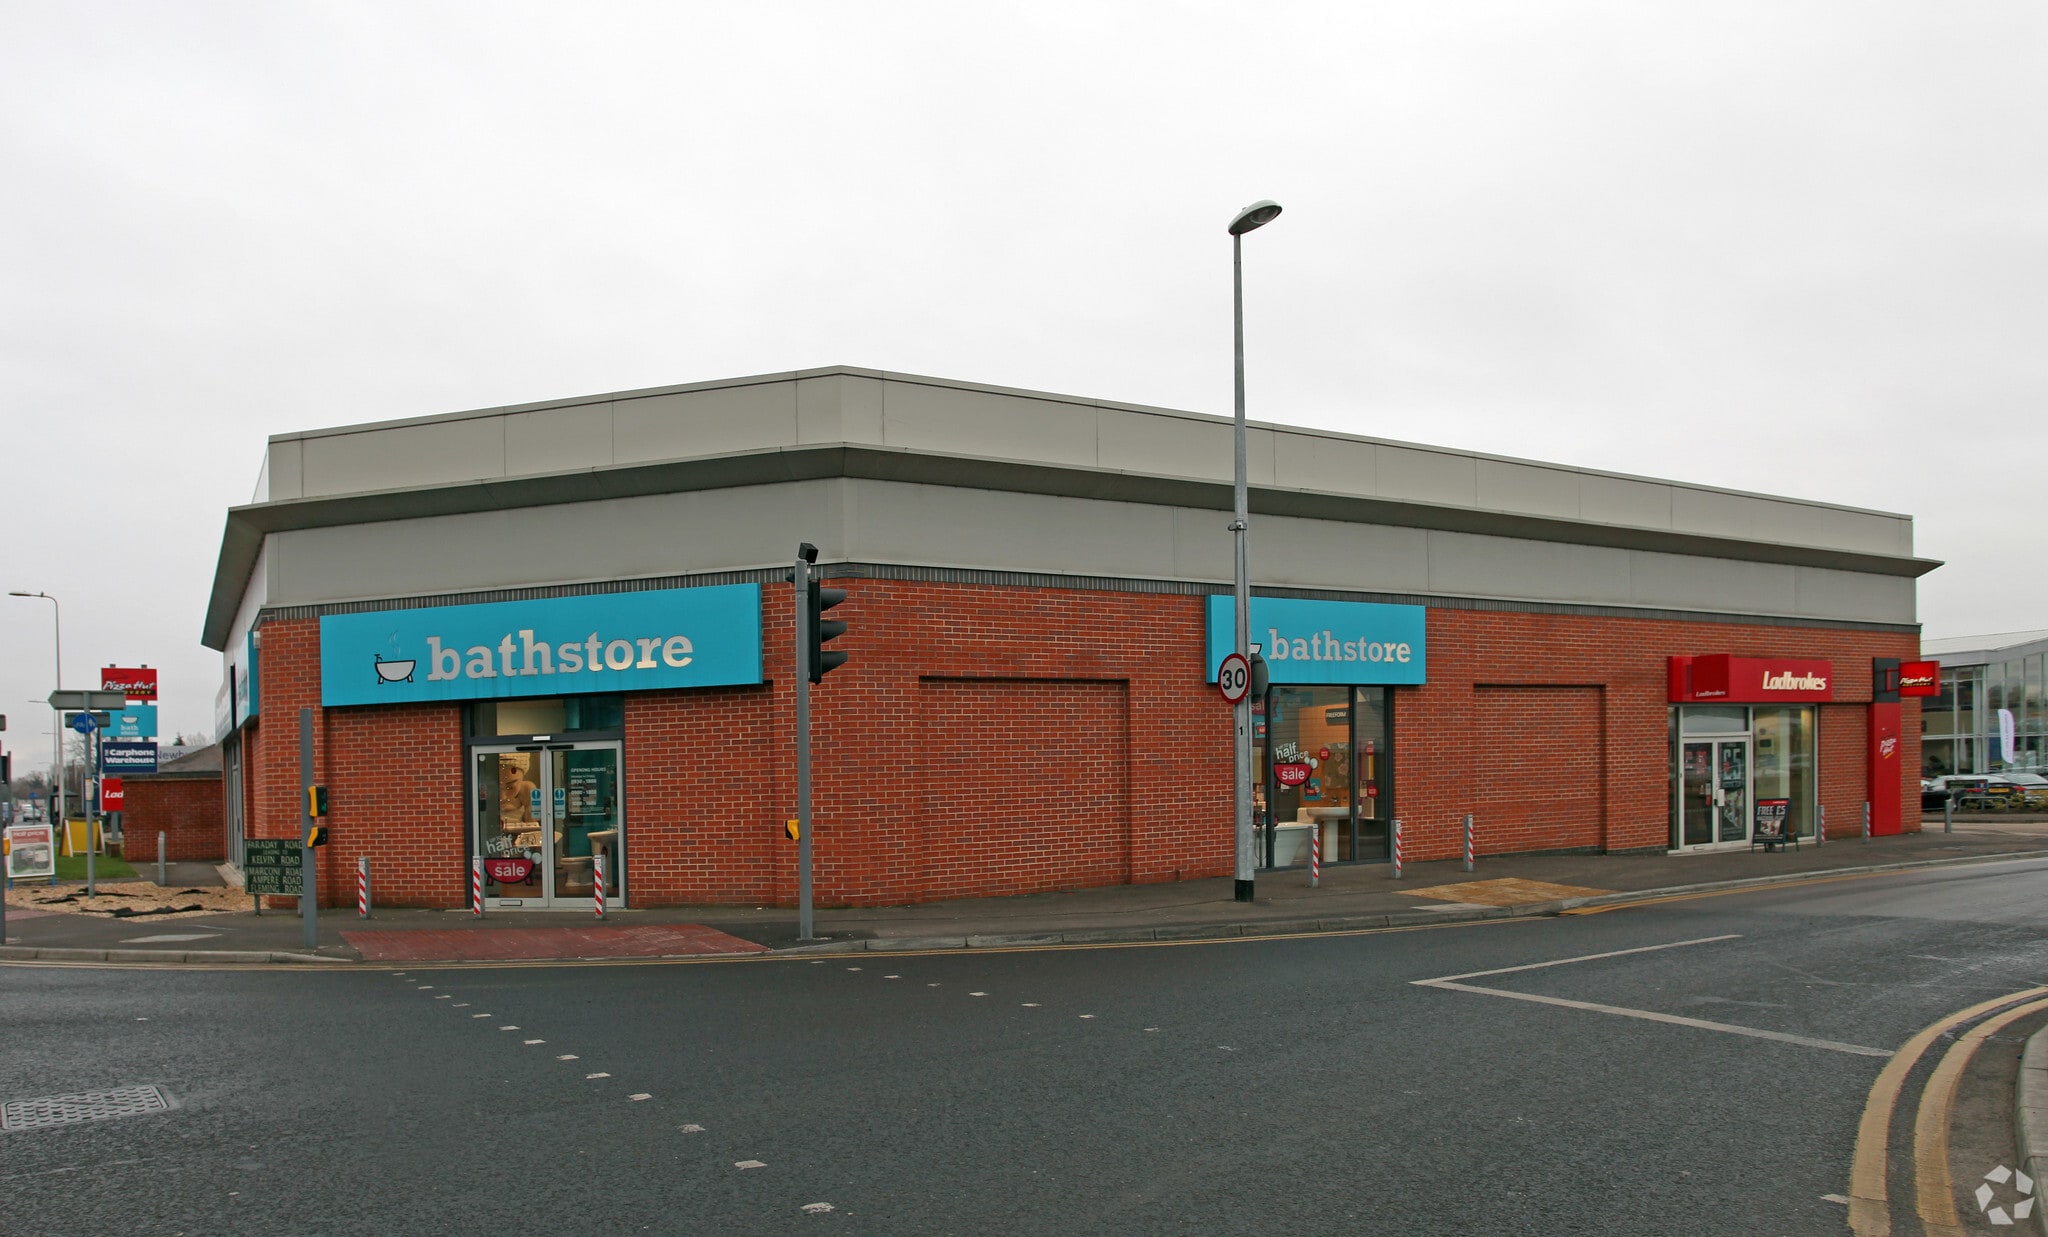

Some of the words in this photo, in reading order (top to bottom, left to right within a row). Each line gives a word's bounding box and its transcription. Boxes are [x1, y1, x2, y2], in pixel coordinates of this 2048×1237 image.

[1268, 628, 1411, 662] bathstore
[426, 629, 694, 681] bathstore
[1222, 668, 1246, 689] 30
[1762, 671, 1827, 690] Ladbrokes
[103, 680, 132, 691] Pizza
[133, 680, 156, 690] Hut
[1251, 699, 1265, 711] sal
[1239, 726, 1244, 736] 1
[109, 748, 155, 757] Carphone
[1276, 742, 1297, 760] half
[1282, 767, 1305, 780] sale
[247, 840, 278, 849] FARADAY
[486, 834, 513, 854] half
[251, 855, 275, 864] KELVIN
[280, 855, 300, 865] ROAD
[248, 867, 281, 876] MARCONI
[495, 862, 526, 877] sale
[252, 876, 280, 884] AMPERE
[282, 876, 302, 885] ROAD
[250, 884, 280, 893] FLEMING
[284, 885, 304, 894] ROAD
